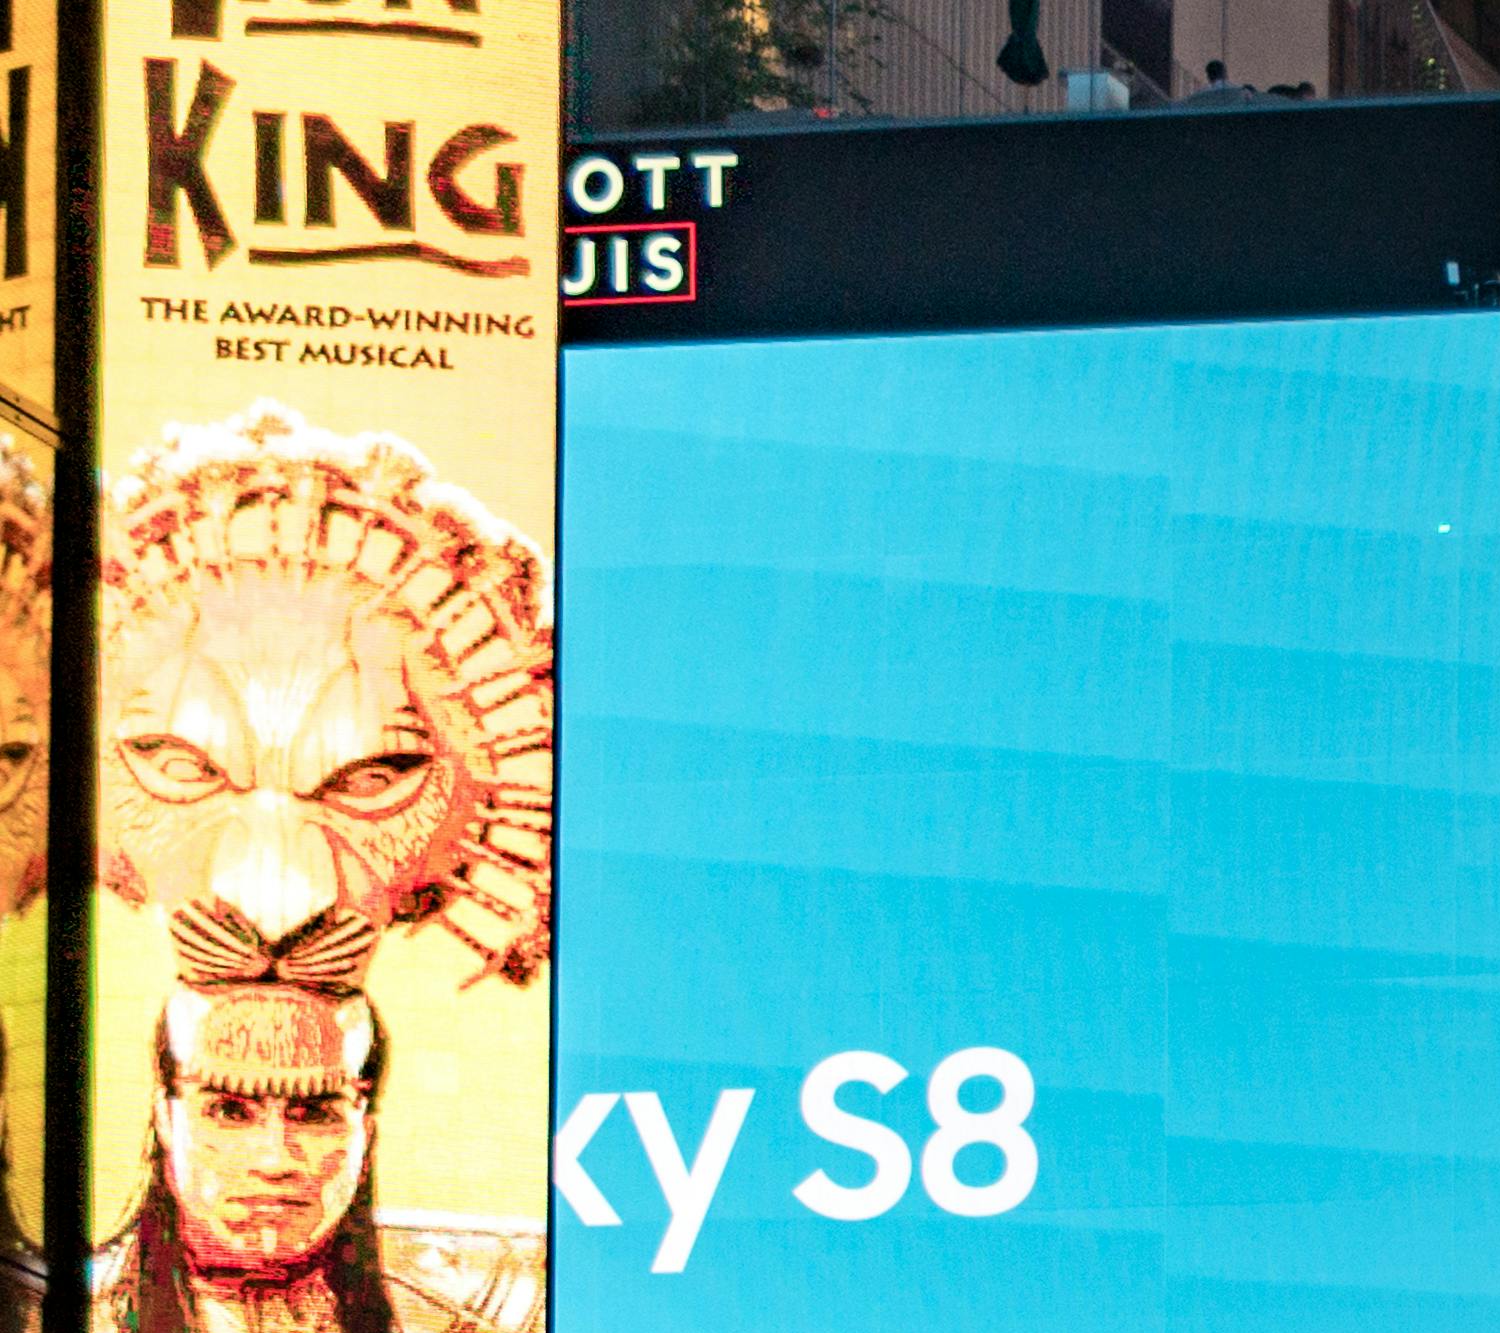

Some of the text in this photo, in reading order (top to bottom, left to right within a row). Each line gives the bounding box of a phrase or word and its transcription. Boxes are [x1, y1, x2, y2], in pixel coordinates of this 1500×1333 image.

[143, 57, 527, 270] KING
[141, 297, 537, 340] THE AWARD-WINNING
[216, 339, 455, 371] BEST MUSICAL
[792, 1046, 1039, 1221] S8
